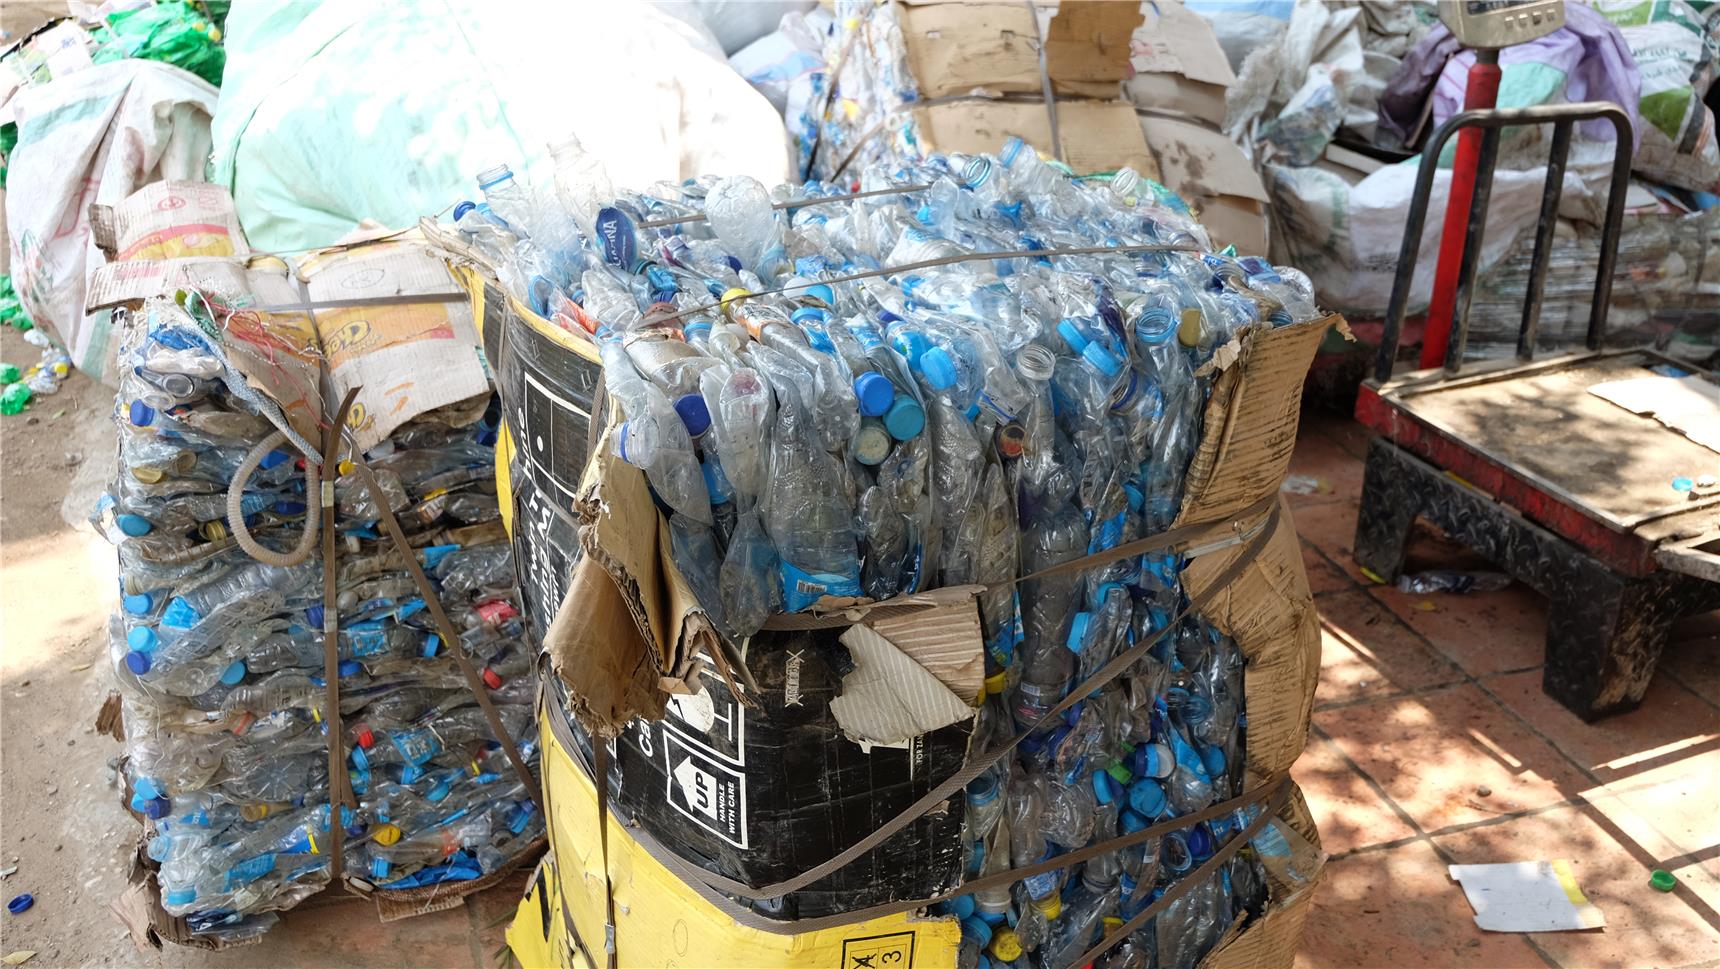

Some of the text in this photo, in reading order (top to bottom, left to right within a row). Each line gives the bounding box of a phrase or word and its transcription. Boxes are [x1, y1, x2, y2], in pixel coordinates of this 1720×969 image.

[529, 521, 539, 585] Twin
[695, 771, 709, 809] UP
[727, 809, 736, 834] WITH
[881, 950, 902, 964] 3
